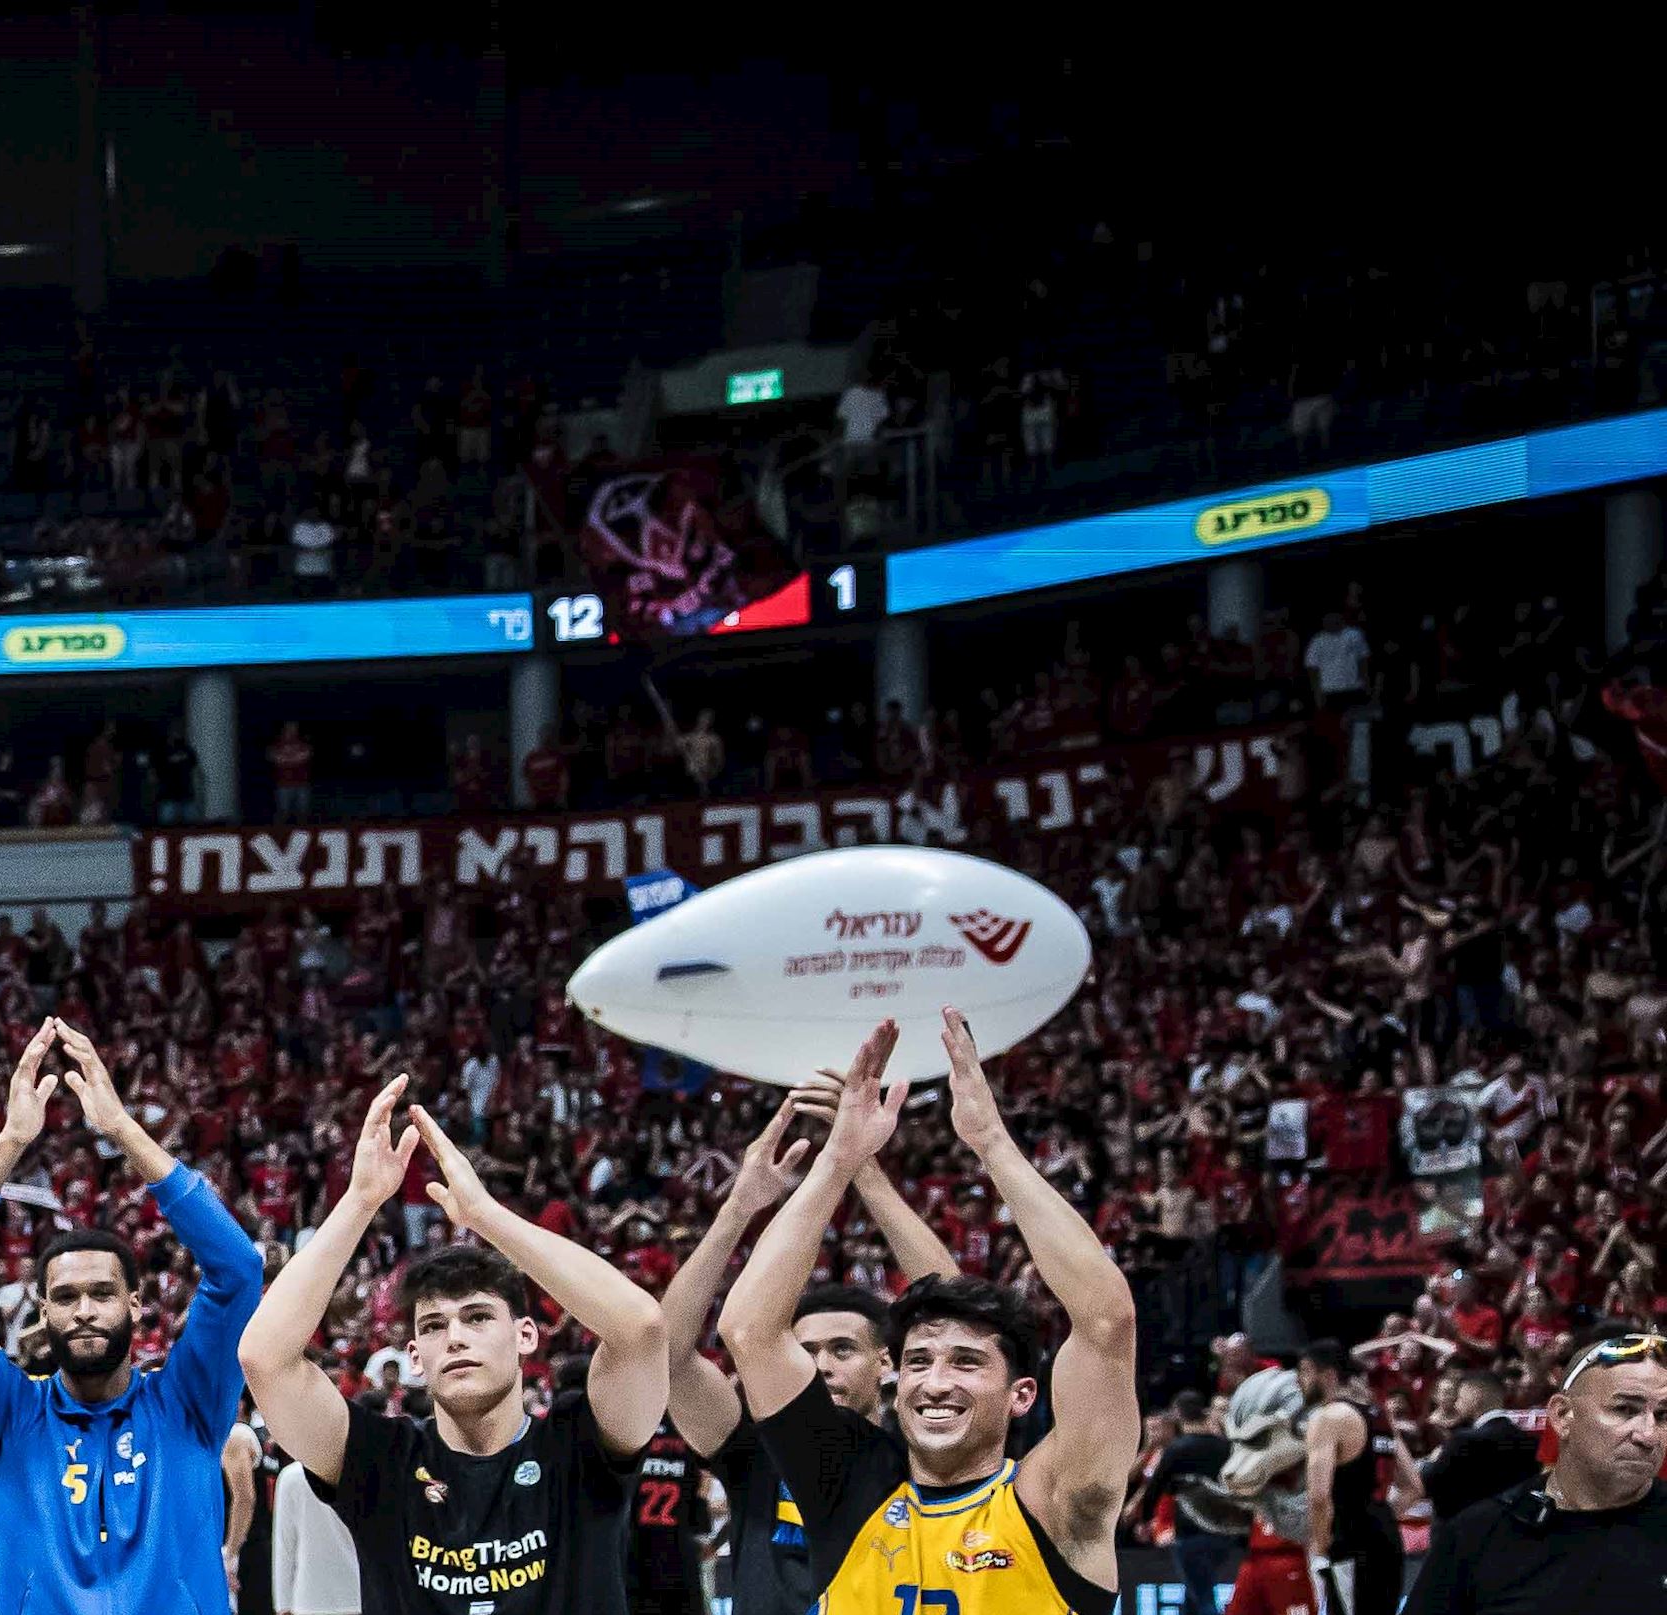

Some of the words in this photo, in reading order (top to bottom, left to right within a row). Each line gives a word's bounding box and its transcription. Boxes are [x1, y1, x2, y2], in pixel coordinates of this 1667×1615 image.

[1214, 500, 1310, 534] ספרינג
[549, 595, 604, 642] 12
[151, 829, 422, 893] תנצח!
[457, 816, 664, 884] והיא
[825, 908, 923, 941] עזריאלי
[63, 1464, 88, 1504] 5
[639, 1481, 681, 1525] 22
[416, 1559, 546, 1595] HomeNow
